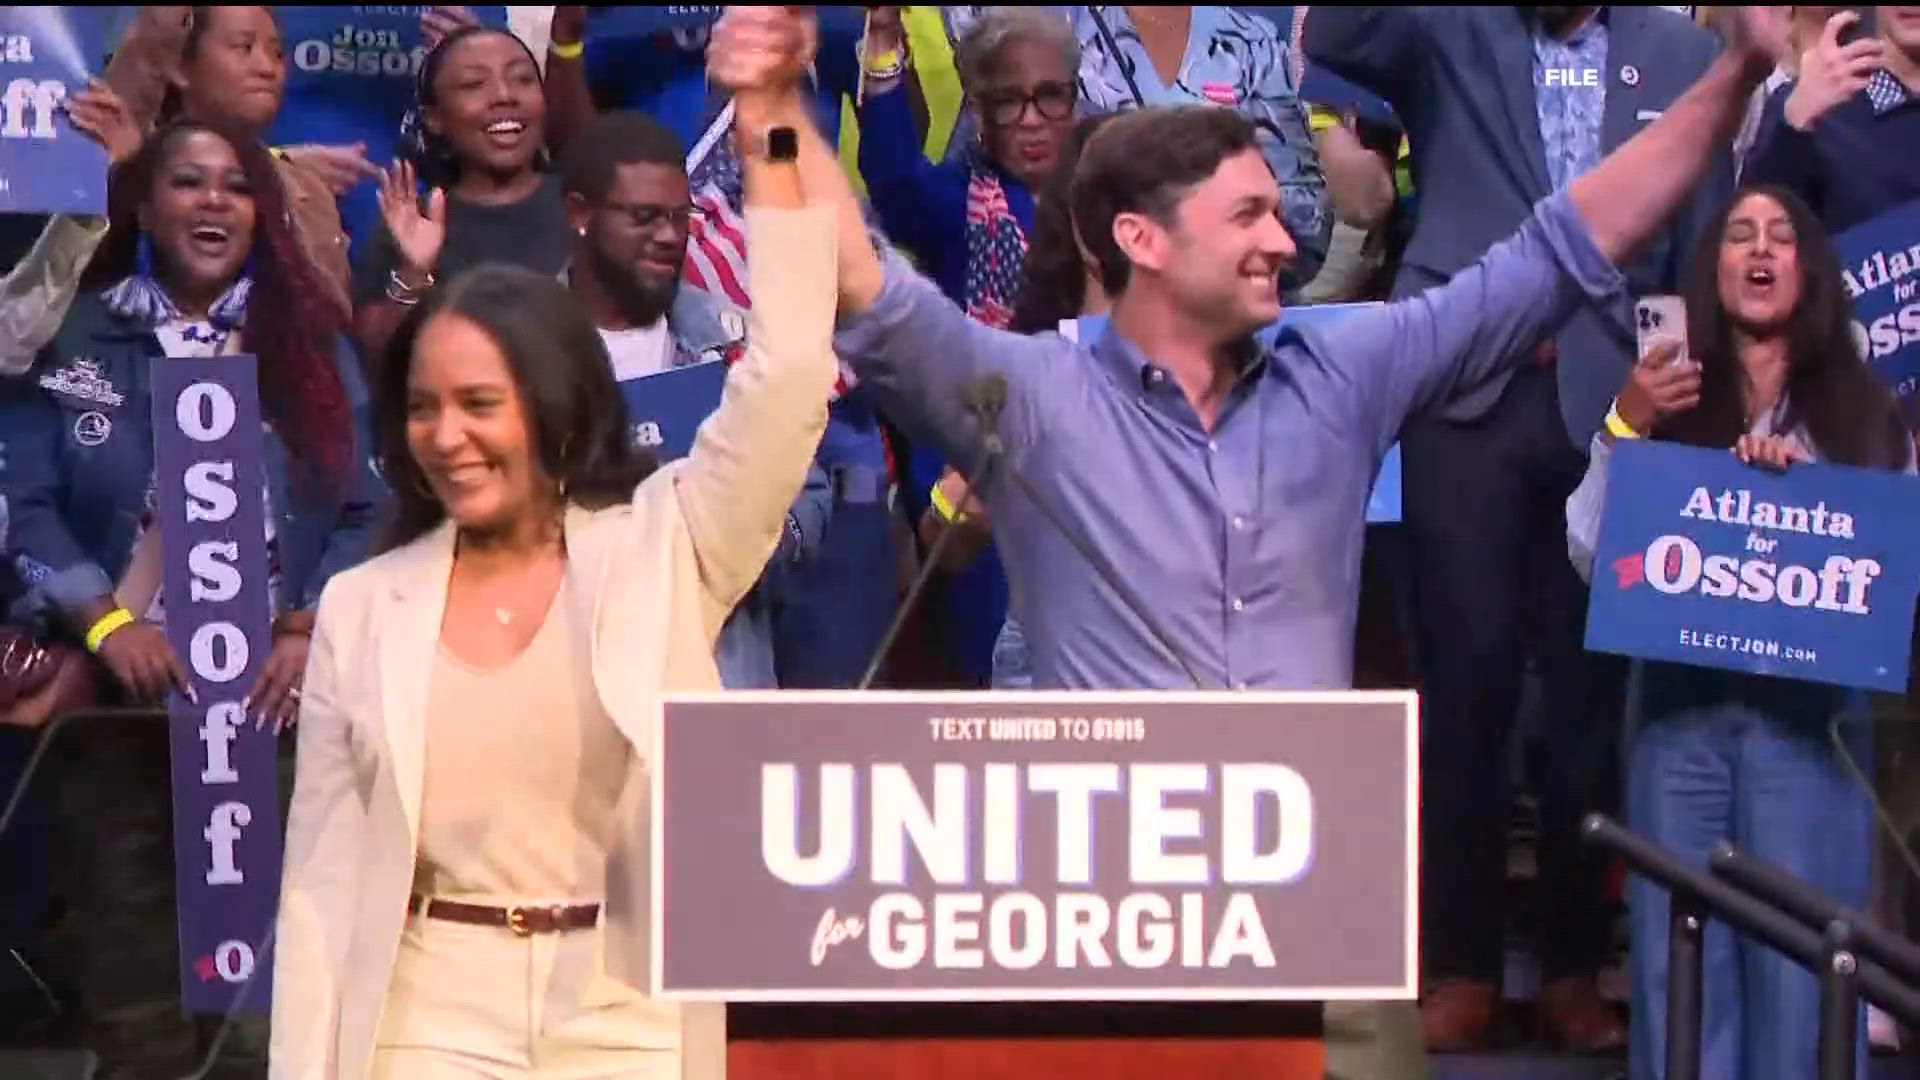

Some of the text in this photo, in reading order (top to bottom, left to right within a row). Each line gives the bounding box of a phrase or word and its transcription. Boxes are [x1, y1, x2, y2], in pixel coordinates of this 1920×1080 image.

[1893, 279, 1917, 304] for
[1680, 486, 1855, 539] Atlanta
[1745, 534, 1778, 554] for
[1645, 534, 1881, 615] Ossoff
[930, 717, 986, 741] TEXT
[989, 717, 1057, 740] UNITED
[1060, 717, 1090, 741] TO
[761, 763, 1315, 888] UNITED
[811, 892, 1277, 969] for GEORGIA
